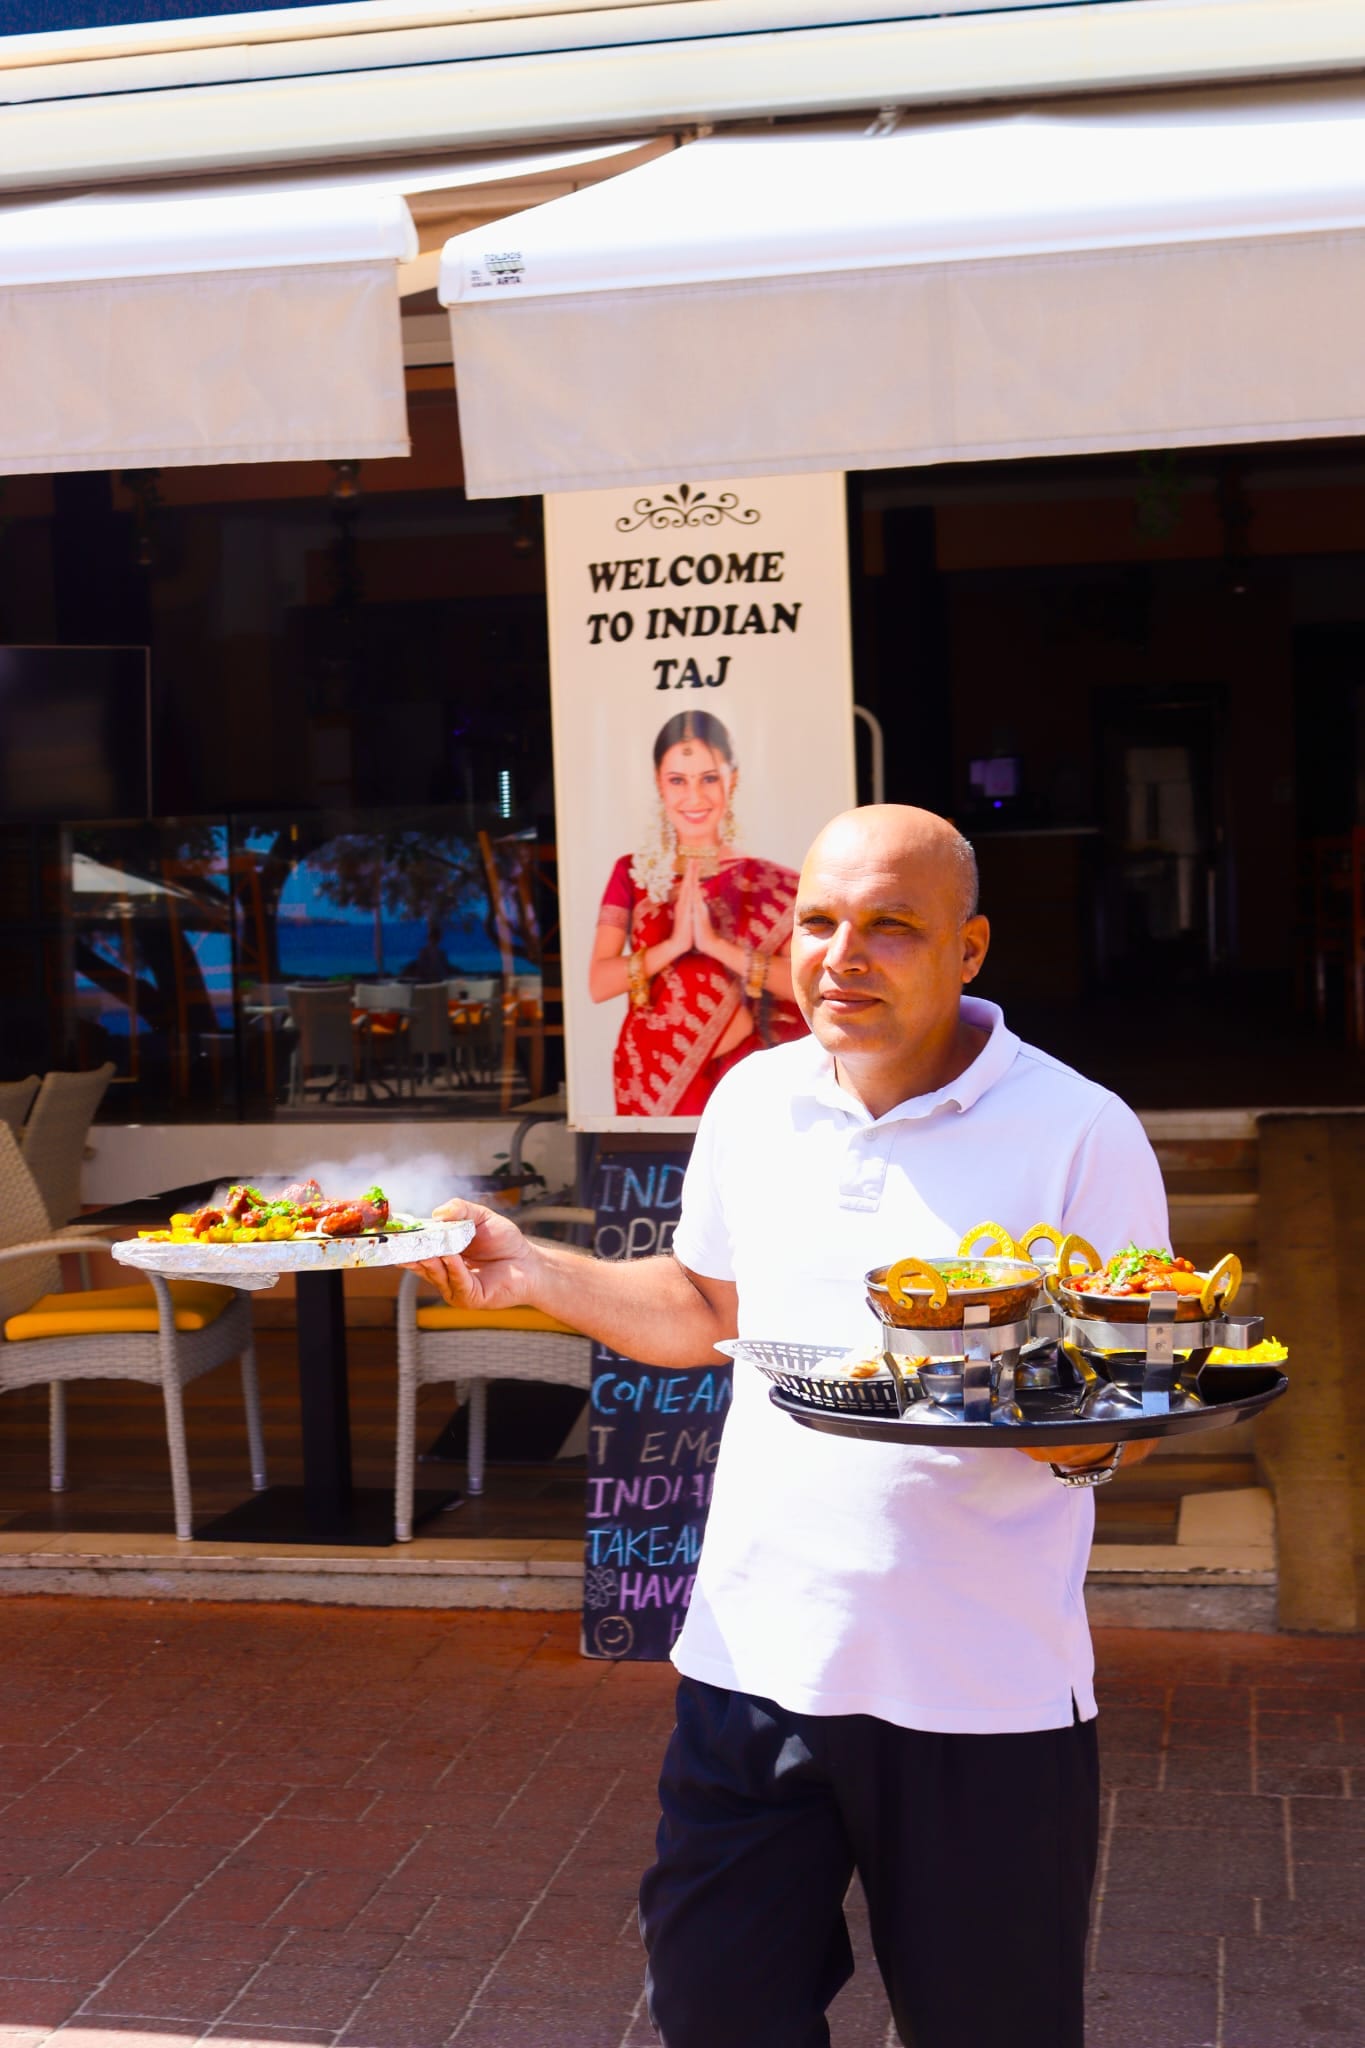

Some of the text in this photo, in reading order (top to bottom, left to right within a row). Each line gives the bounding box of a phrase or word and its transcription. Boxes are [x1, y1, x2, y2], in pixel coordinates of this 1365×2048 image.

[588, 551, 785, 593] WELCOME
[587, 602, 802, 645] TO INDIAN
[653, 656, 732, 690] TAJ
